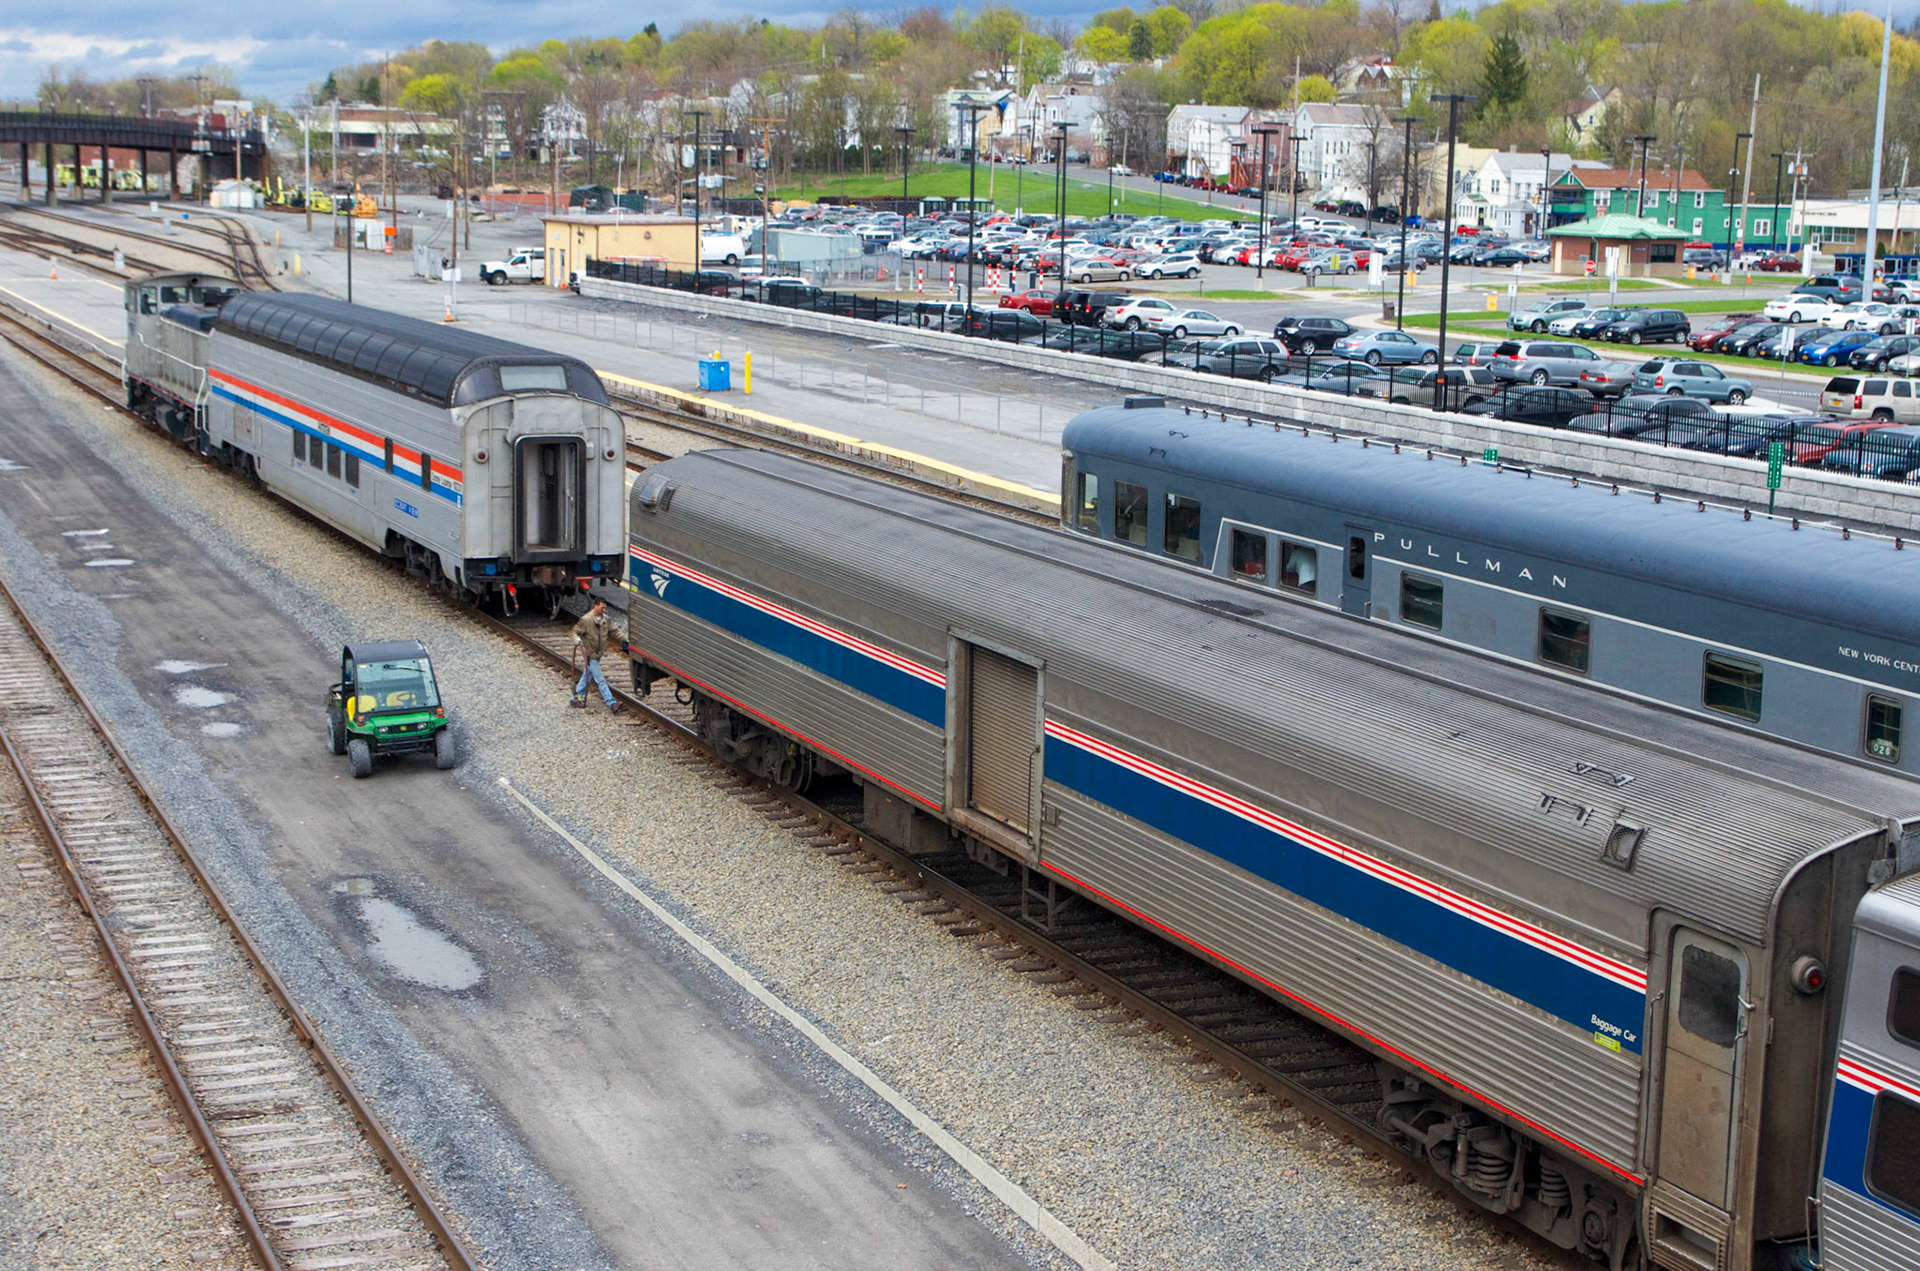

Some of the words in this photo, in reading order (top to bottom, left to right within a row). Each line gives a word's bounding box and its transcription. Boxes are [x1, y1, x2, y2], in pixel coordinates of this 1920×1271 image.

[1374, 532, 1567, 589] PULLMAN
[1838, 646, 1859, 659] NEW
[1863, 652, 1891, 667] YORK
[1893, 660, 1920, 674] CENT
[1873, 743, 1891, 755] 026
[1591, 1014, 1622, 1036] Baggage
[1623, 1030, 1637, 1042] Car
